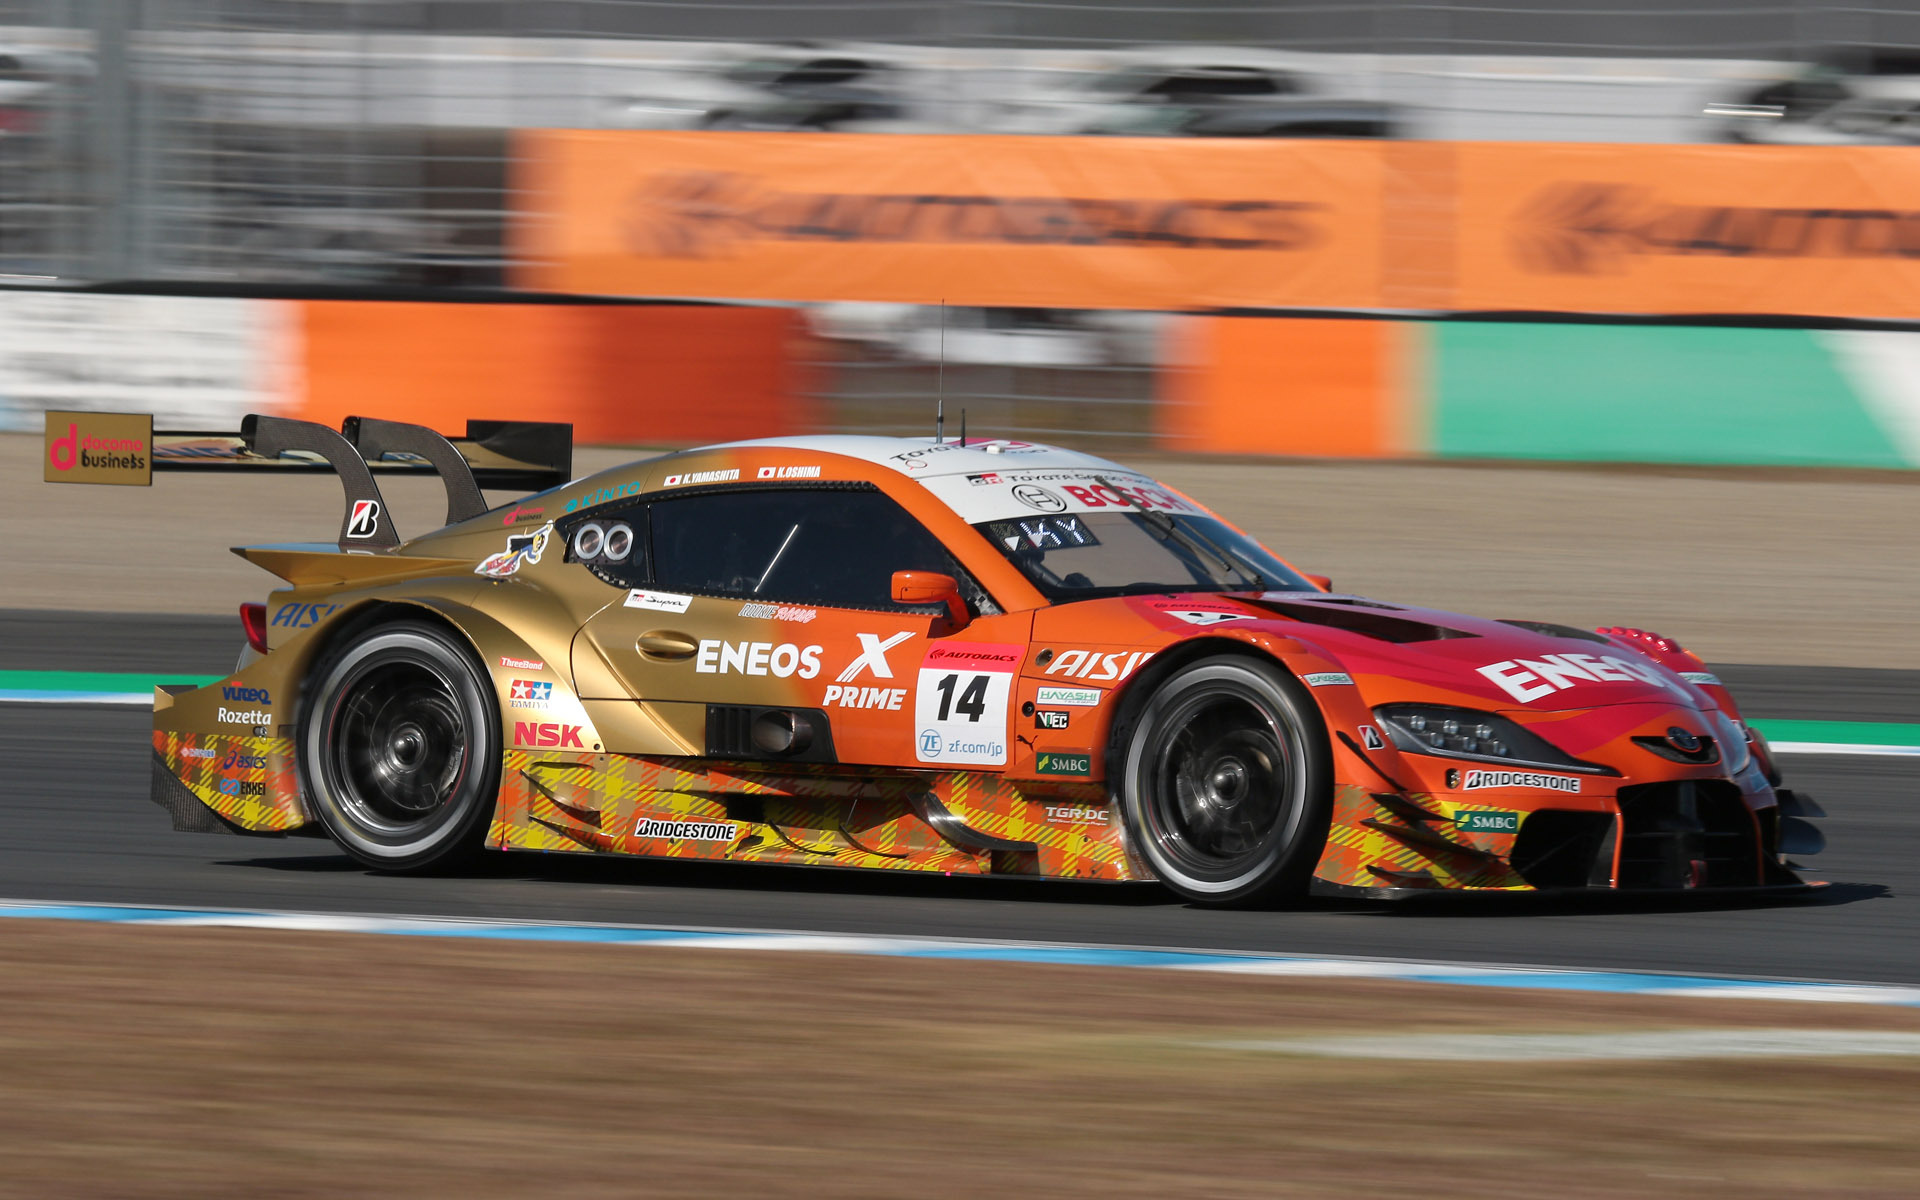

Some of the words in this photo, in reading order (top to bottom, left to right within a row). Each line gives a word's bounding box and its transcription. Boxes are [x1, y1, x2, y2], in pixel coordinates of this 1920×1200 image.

[81, 433, 143, 452] docomo
[682, 469, 740, 485] K.YAMASHITA
[776, 466, 821, 479] K.OSHIMA
[1006, 474, 1072, 483] TOYOTA
[645, 595, 685, 608] Supra
[696, 639, 824, 680] ENEOS
[943, 650, 1017, 662] AUTOBACS
[501, 657, 543, 670] ThreeBond
[822, 685, 907, 711] PRIME
[937, 673, 990, 723] 14
[1039, 690, 1097, 701] HAYASHI
[510, 700, 549, 709] TAMIYA
[218, 707, 272, 725] Rozetta
[514, 721, 585, 748] NSK
[949, 740, 1003, 757] zf.com/jp
[237, 756, 267, 769] asics
[1051, 758, 1088, 772] SMBC
[241, 782, 266, 796] ENKEI
[1466, 771, 1580, 793] BRIDGESTONE
[1472, 815, 1516, 829] SMBC
[637, 819, 735, 840] BRIDGESTONE
